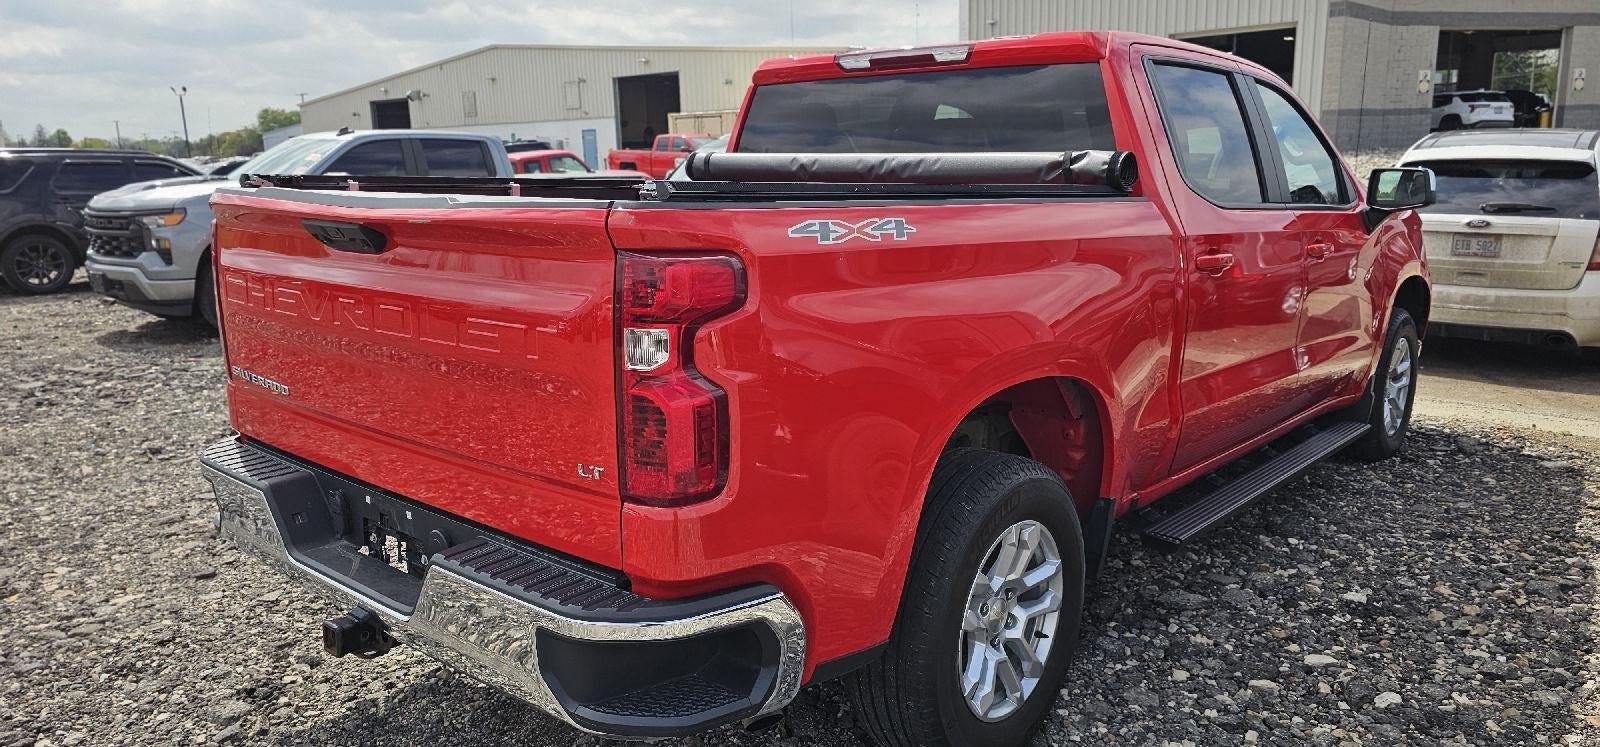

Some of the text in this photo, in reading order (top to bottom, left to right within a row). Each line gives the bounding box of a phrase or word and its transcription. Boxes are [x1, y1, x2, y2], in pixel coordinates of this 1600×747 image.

[225, 273, 558, 360] CHEVROLET
[231, 365, 290, 396] SILVERADO
[577, 463, 605, 480] LT
